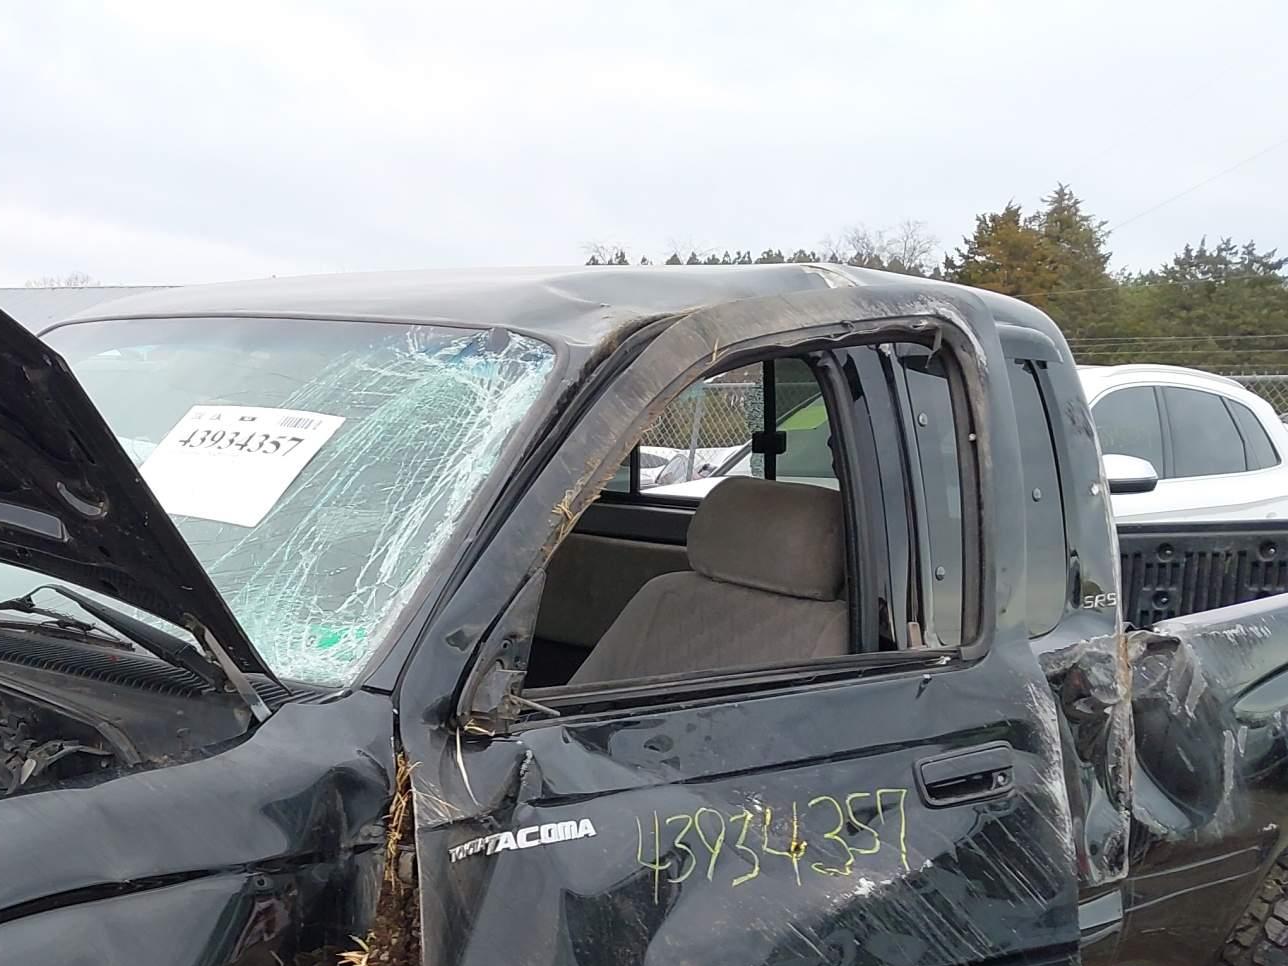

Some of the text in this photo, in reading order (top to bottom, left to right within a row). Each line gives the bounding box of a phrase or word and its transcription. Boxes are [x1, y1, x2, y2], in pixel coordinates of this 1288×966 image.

[178, 428, 305, 457] 43934357
[484, 818, 598, 856] TACOMA
[635, 787, 911, 904] 43934357
